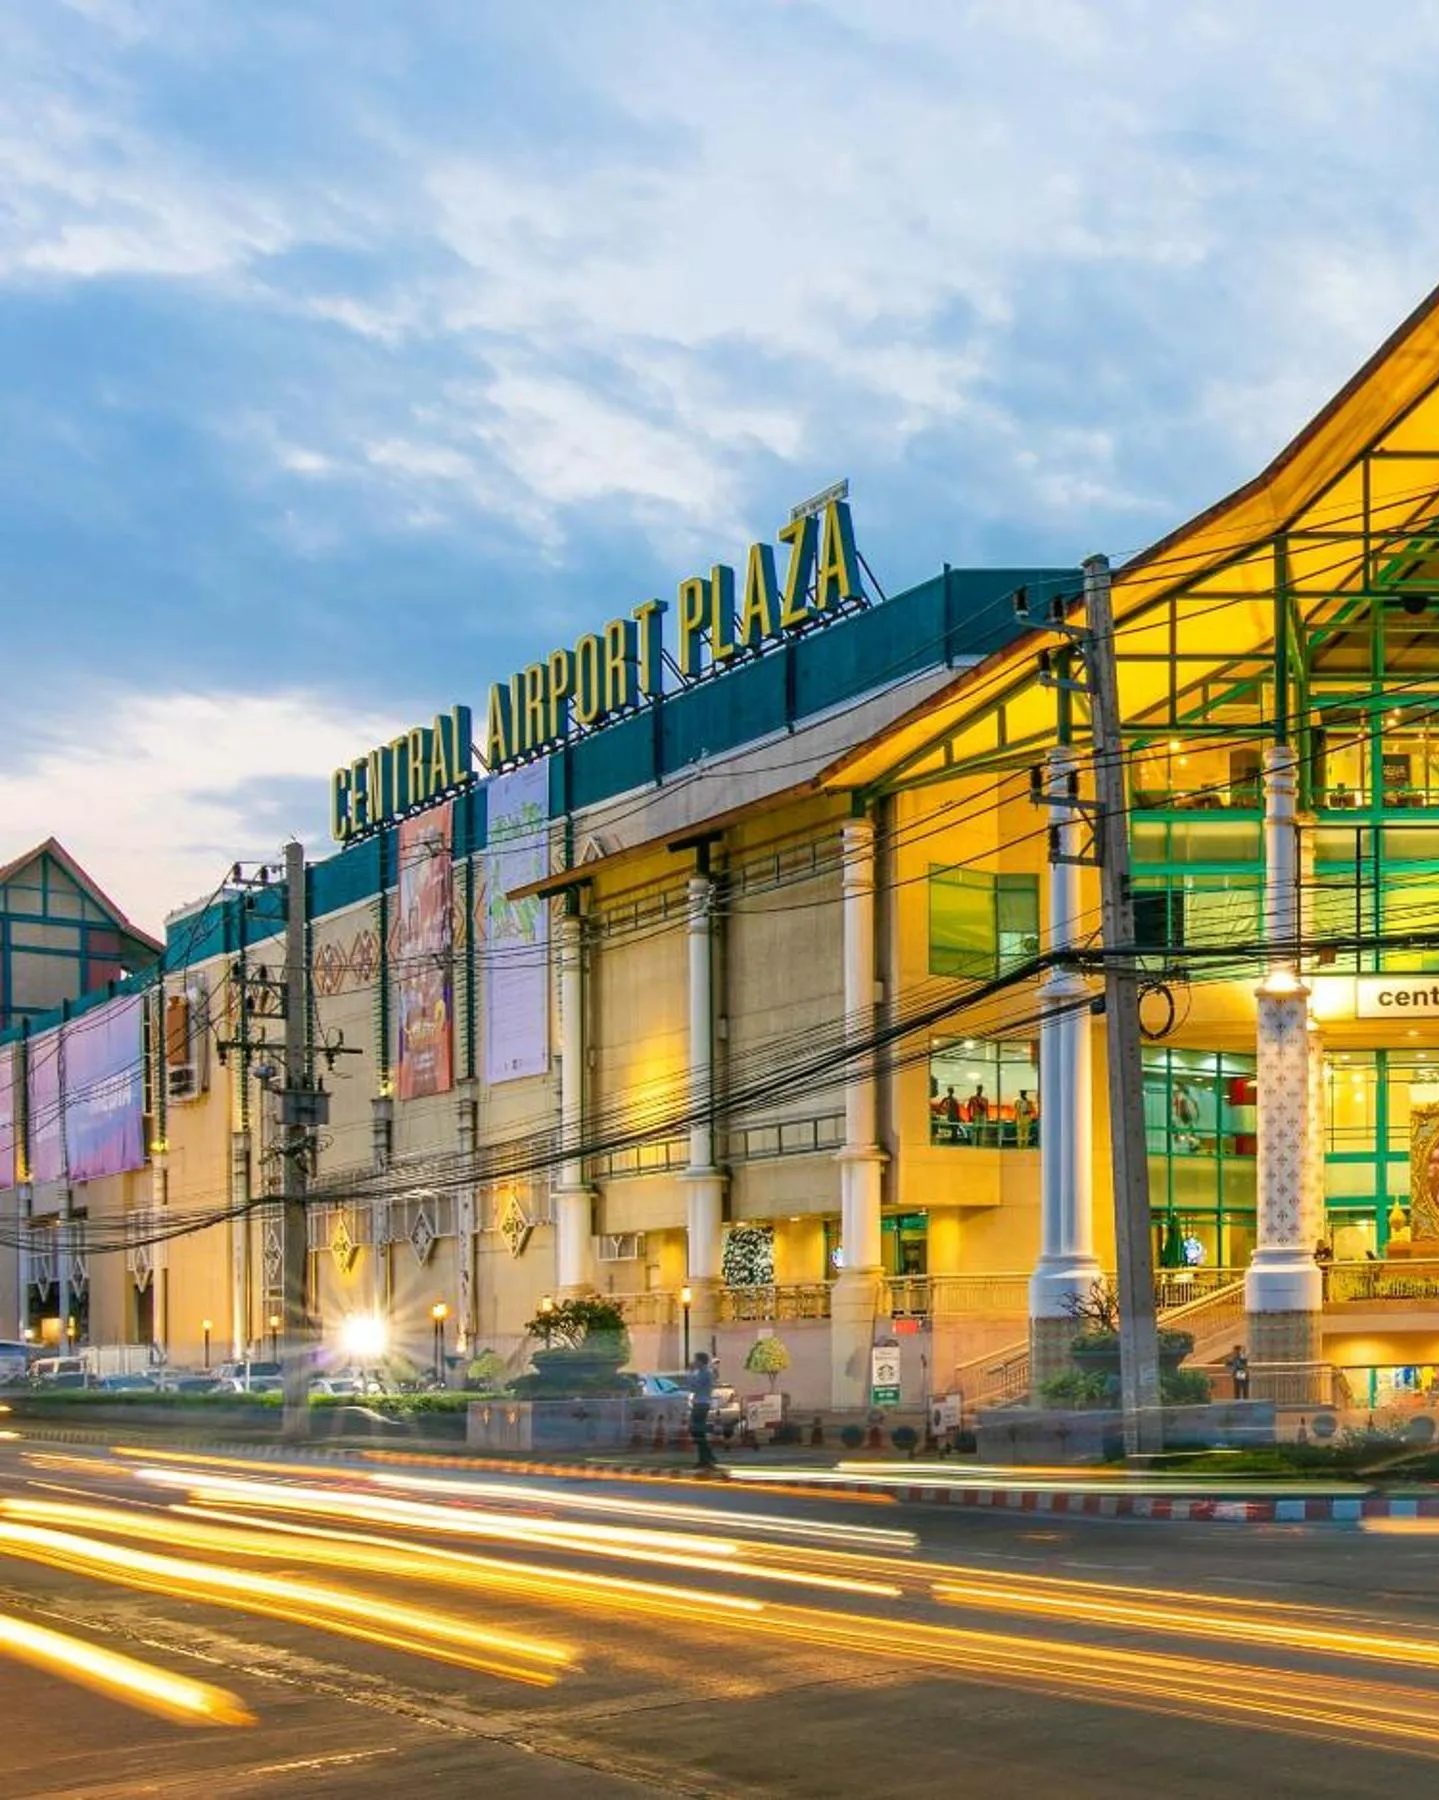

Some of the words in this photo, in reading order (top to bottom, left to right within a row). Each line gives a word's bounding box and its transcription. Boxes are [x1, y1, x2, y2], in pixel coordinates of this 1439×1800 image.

[330, 704, 477, 842] CENTRAL
[487, 598, 668, 772] AIRPORT
[678, 498, 865, 678] PLAZA
